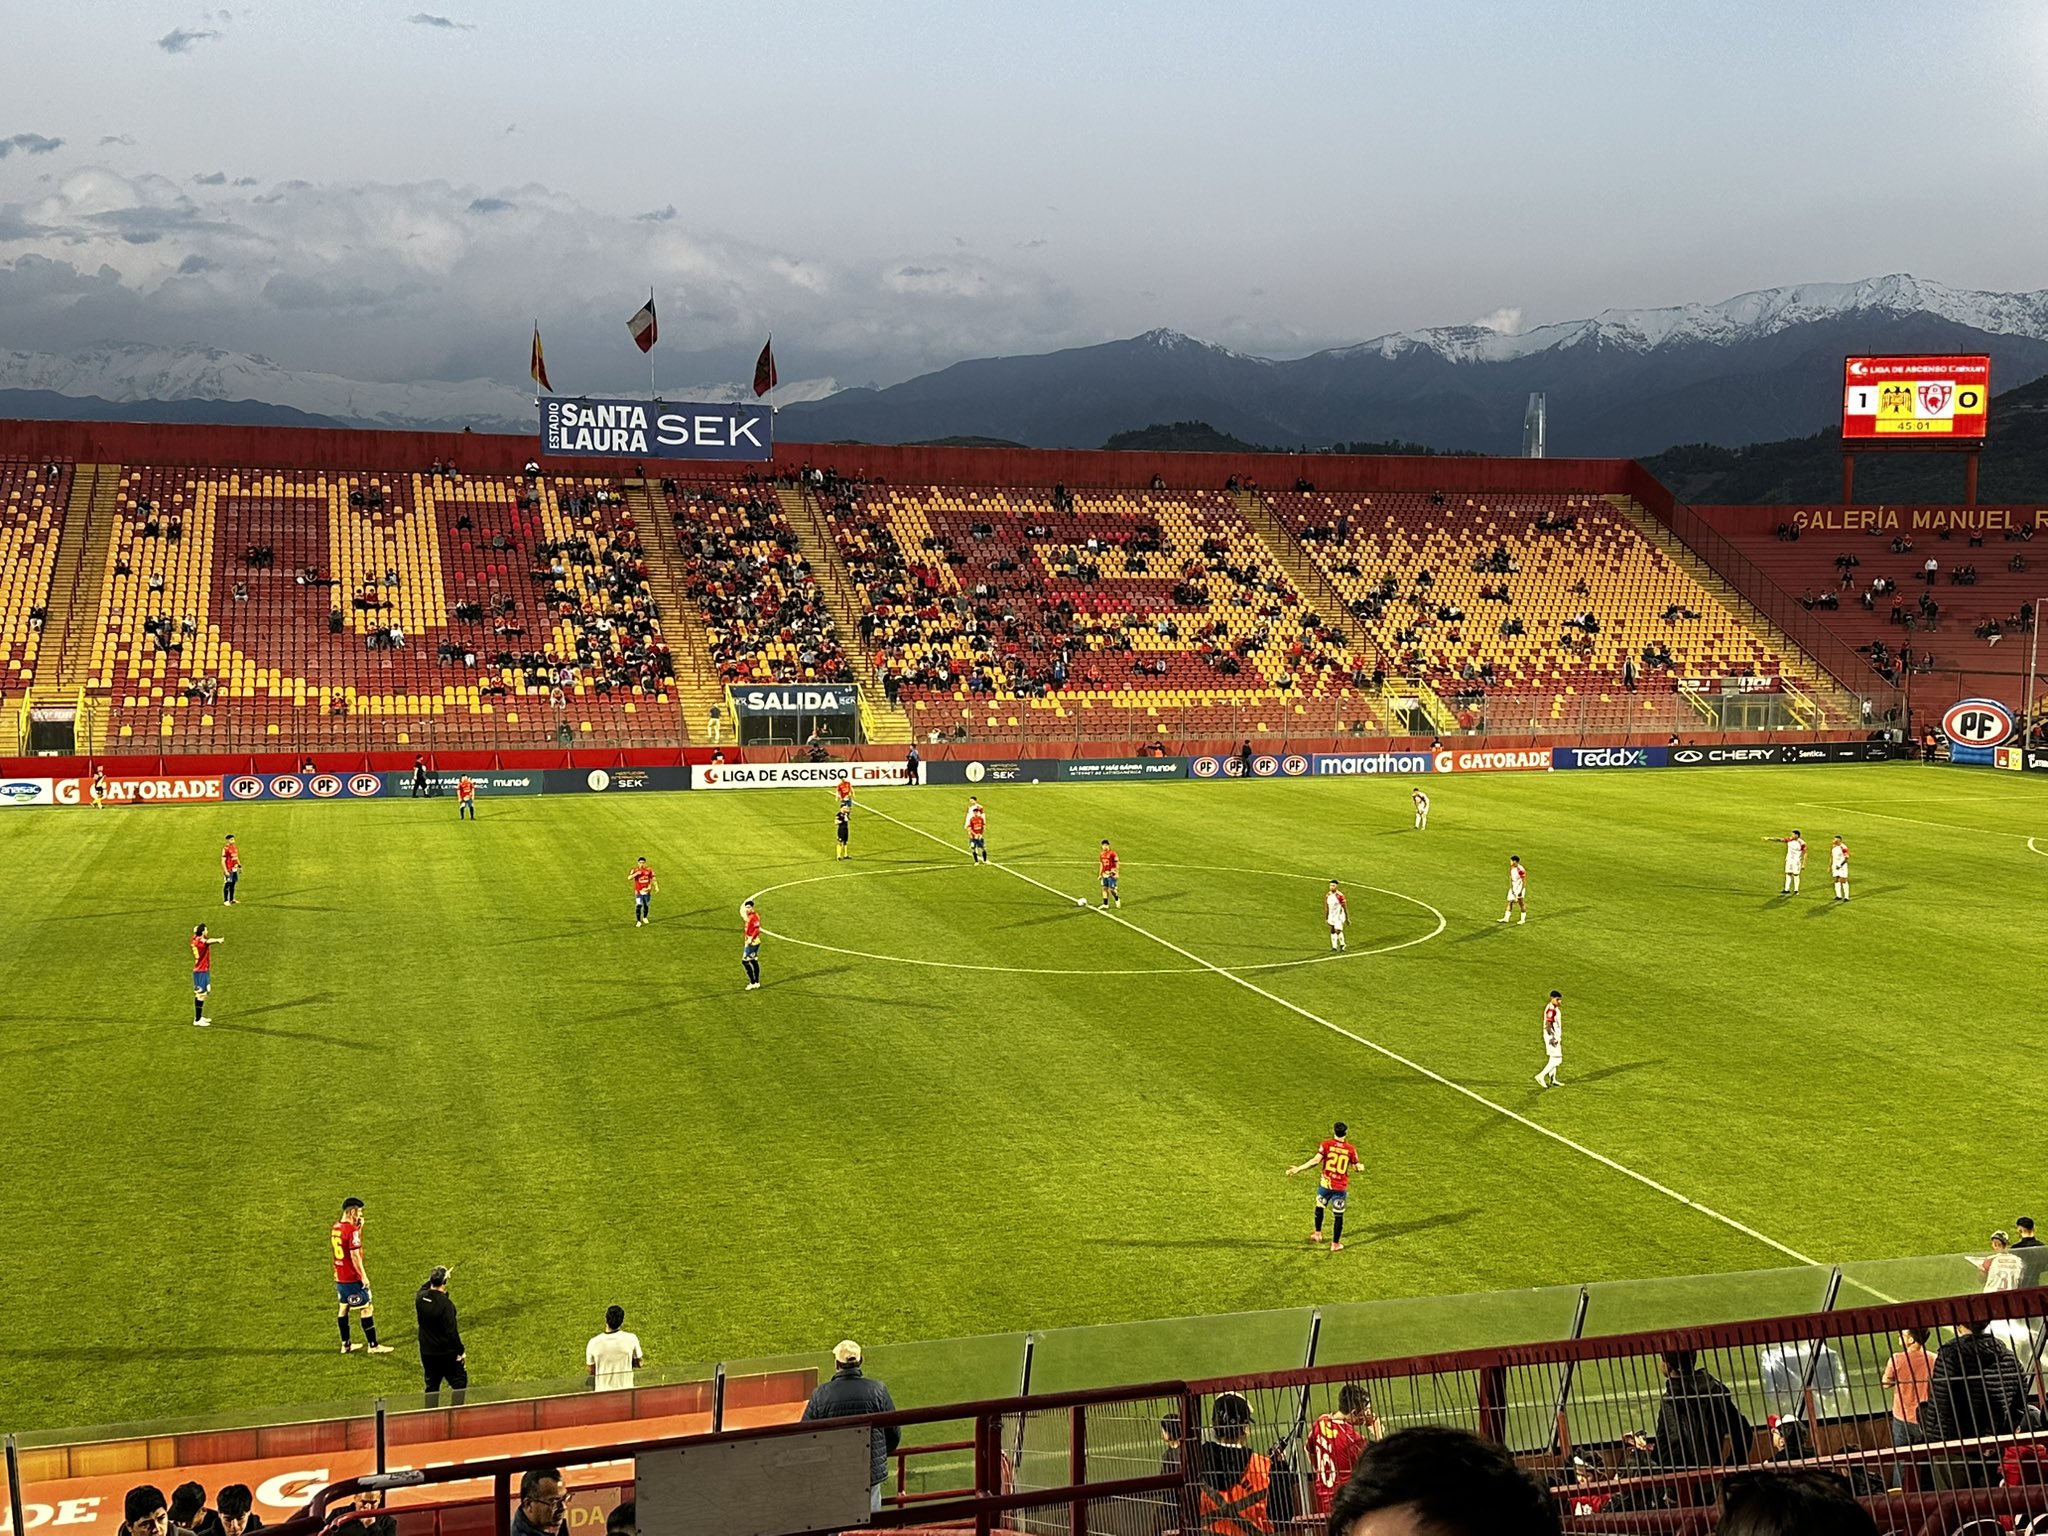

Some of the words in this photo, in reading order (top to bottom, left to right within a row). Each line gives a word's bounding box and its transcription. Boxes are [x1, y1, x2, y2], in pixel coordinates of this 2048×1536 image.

[1869, 366, 1890, 374] LIGA
[1891, 366, 1904, 374] DE
[1905, 365, 1947, 373] ASCENSO
[1858, 393, 1867, 408] 1
[1958, 391, 1978, 409] 0
[560, 402, 648, 429] SANTA
[548, 402, 560, 449] ESTADIO
[656, 413, 763, 448] SEK
[1897, 421, 1931, 431] 45:01
[560, 426, 649, 453] LAURA
[1793, 505, 1899, 530] GALERÍA
[1912, 509, 2014, 530] MANUEL
[747, 691, 839, 711] SALIDA
[1959, 711, 1995, 739] PF
[1434, 751, 1453, 773] G
[1459, 751, 1550, 769] GATORADE
[1708, 749, 1775, 761] CHERY
[1200, 761, 1213, 773] PF
[1259, 760, 1272, 771] PF
[1289, 760, 1302, 771] PF
[1320, 753, 1425, 774] marathon
[722, 770, 755, 782] LIGA
[759, 769, 777, 782] DE
[781, 768, 848, 781] ASCENSO
[992, 771, 1015, 779] SEK
[238, 780, 256, 793] PF
[278, 780, 295, 793] PF
[317, 779, 334, 792] PF
[356, 778, 373, 791] PF
[618, 779, 643, 788] SEK
[55, 778, 80, 805] G
[1325, 1152, 1350, 1175] 20
